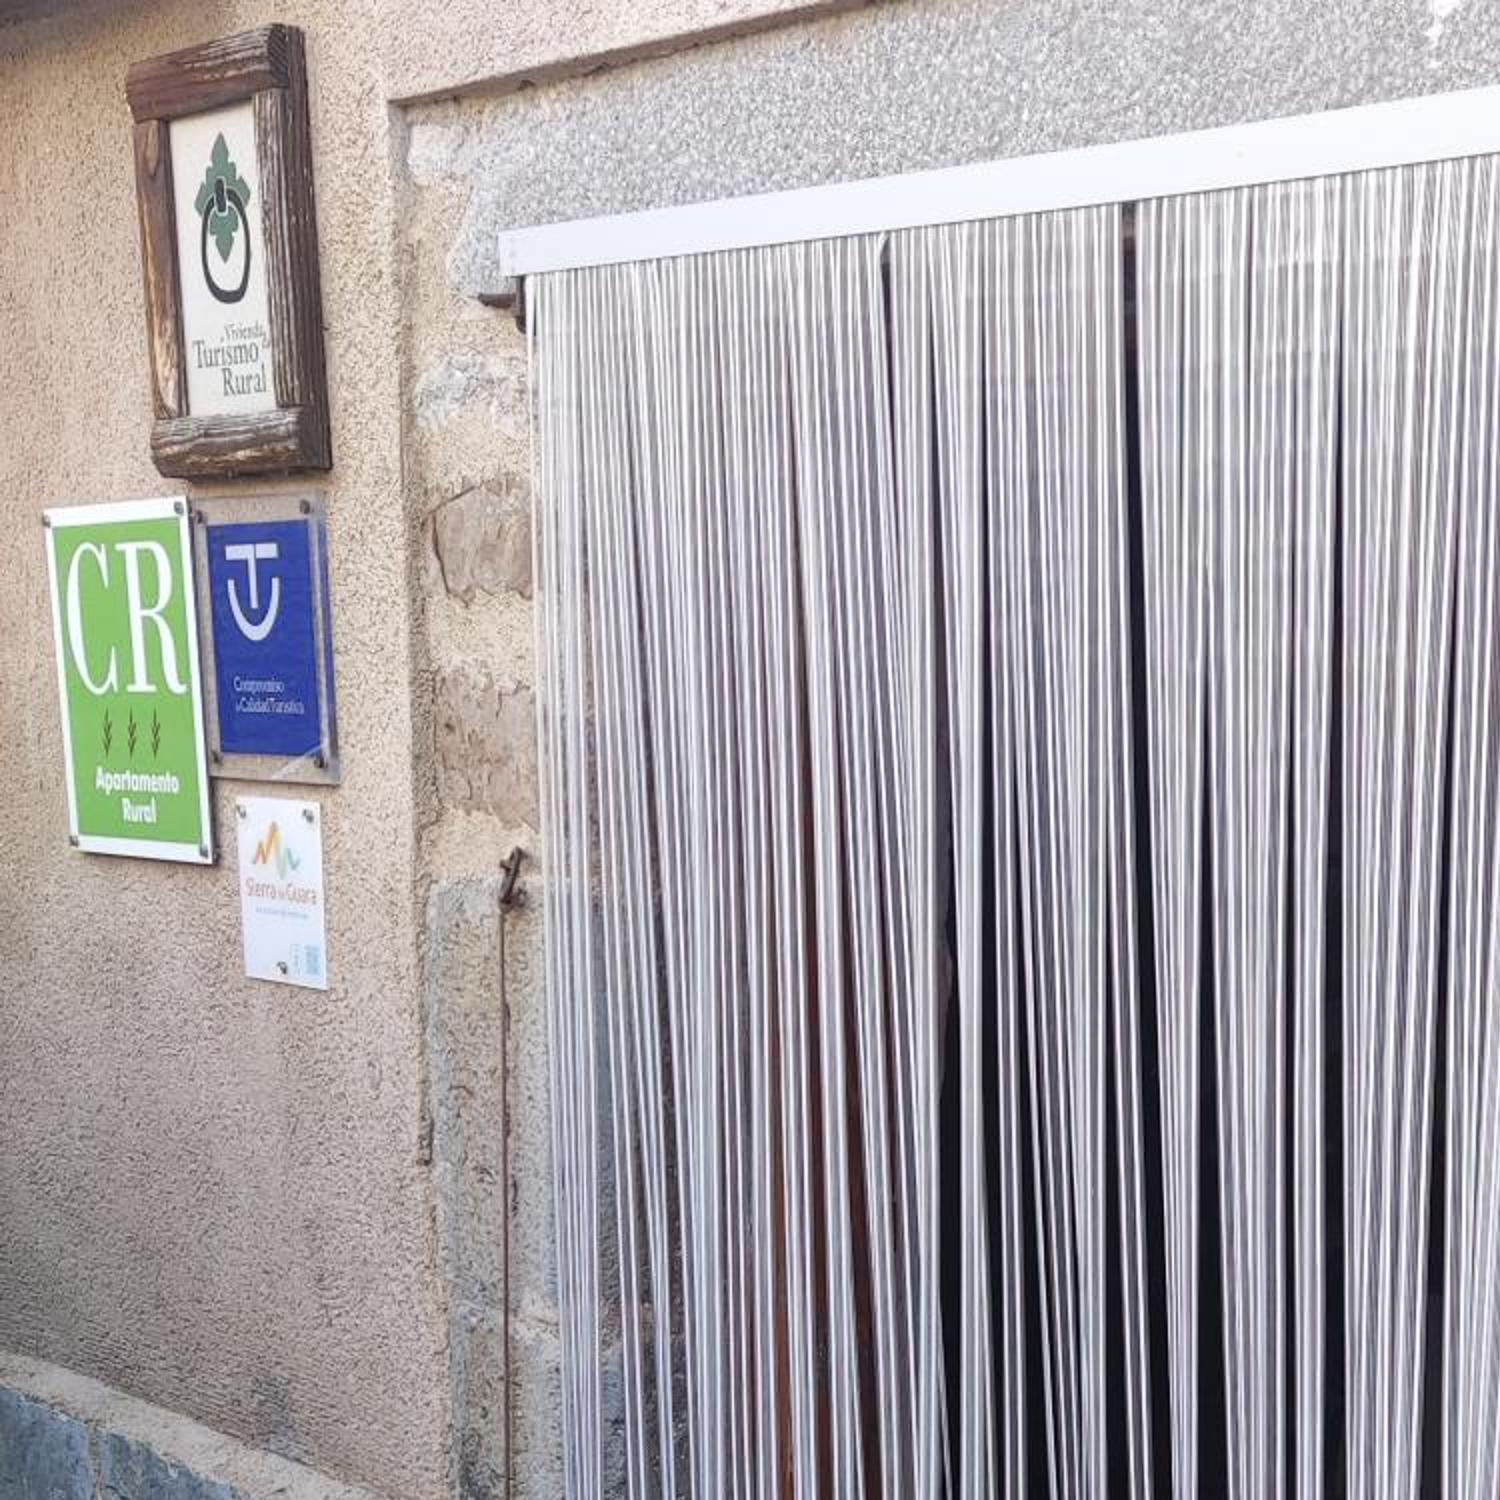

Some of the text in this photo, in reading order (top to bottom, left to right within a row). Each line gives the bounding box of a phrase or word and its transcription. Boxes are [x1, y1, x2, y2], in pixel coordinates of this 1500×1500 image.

[191, 338, 260, 370] Turismo
[221, 361, 268, 398] Rural
[67, 540, 188, 695] CR
[95, 765, 181, 796] Apartamento
[121, 796, 157, 825] Rural
